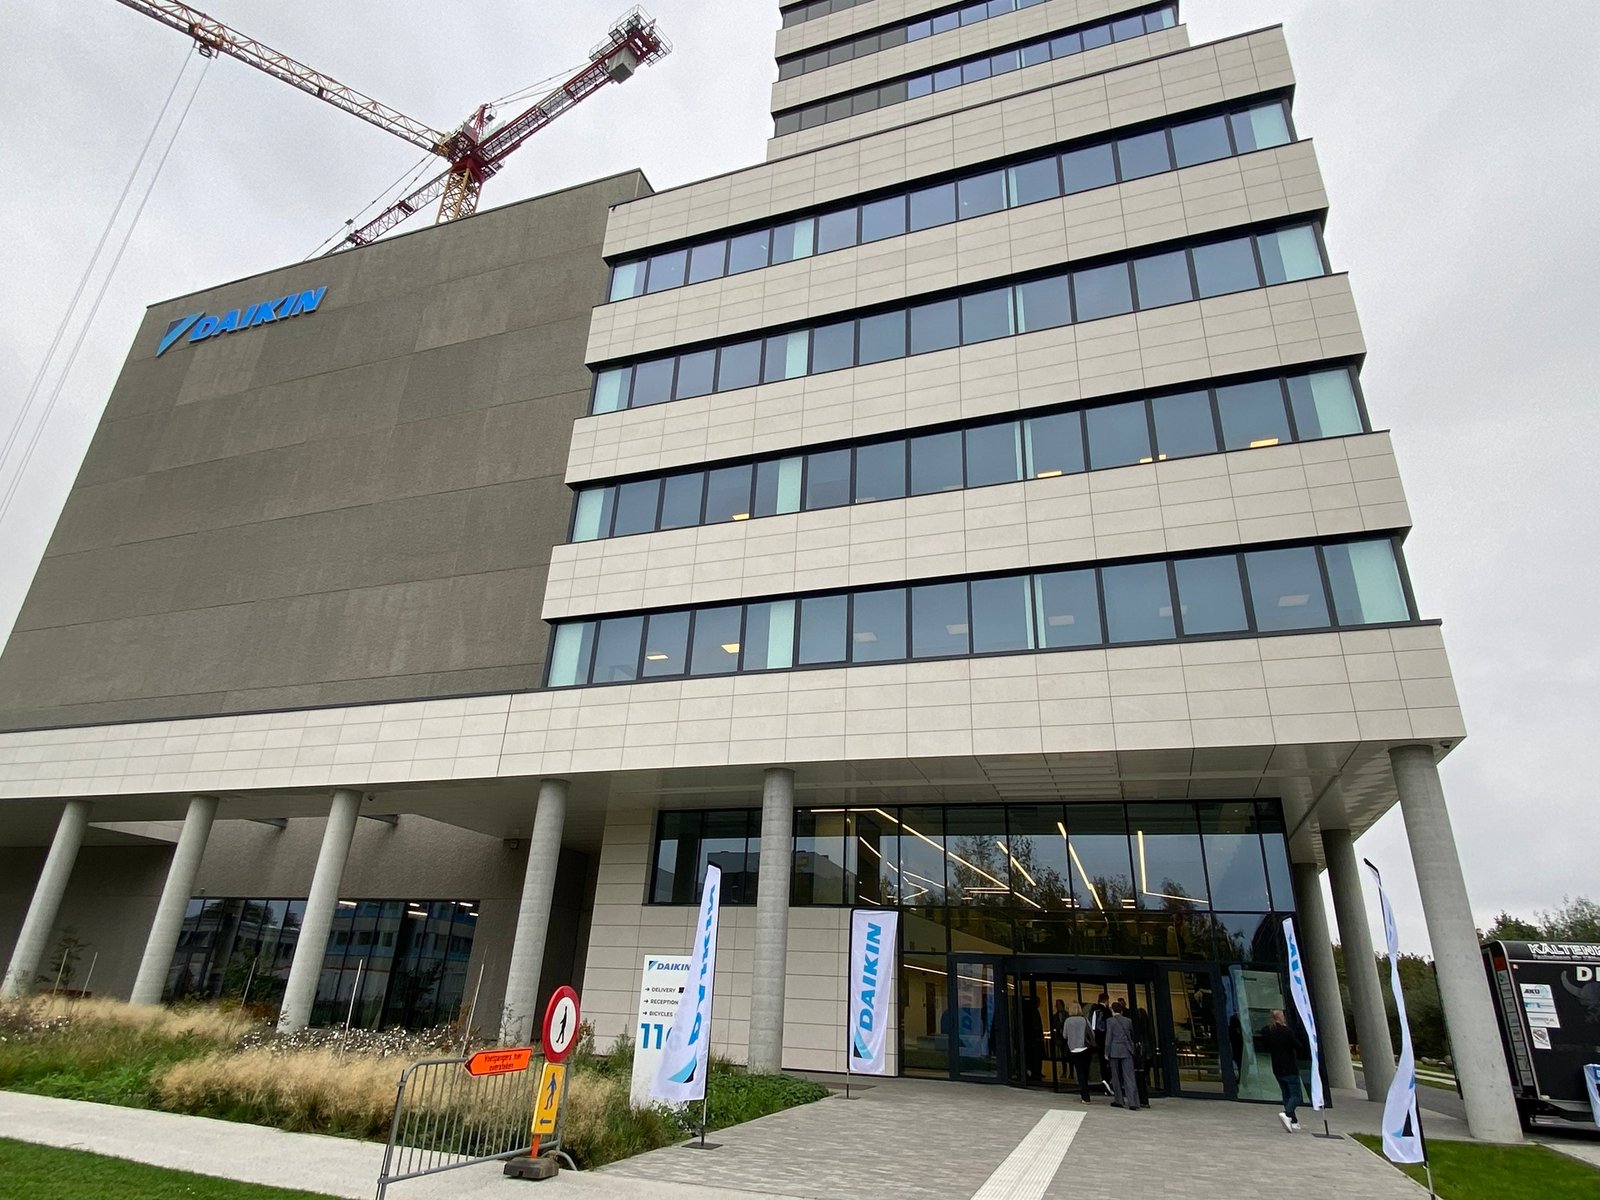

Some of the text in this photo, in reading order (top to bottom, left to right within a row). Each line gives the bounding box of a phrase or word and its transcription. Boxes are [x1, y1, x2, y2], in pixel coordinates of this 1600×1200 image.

[188, 285, 328, 343] DAIKIN
[657, 963, 691, 971] DAIKIN
[860, 922, 882, 1032] DAIKIN
[641, 1023, 672, 1050] 11
